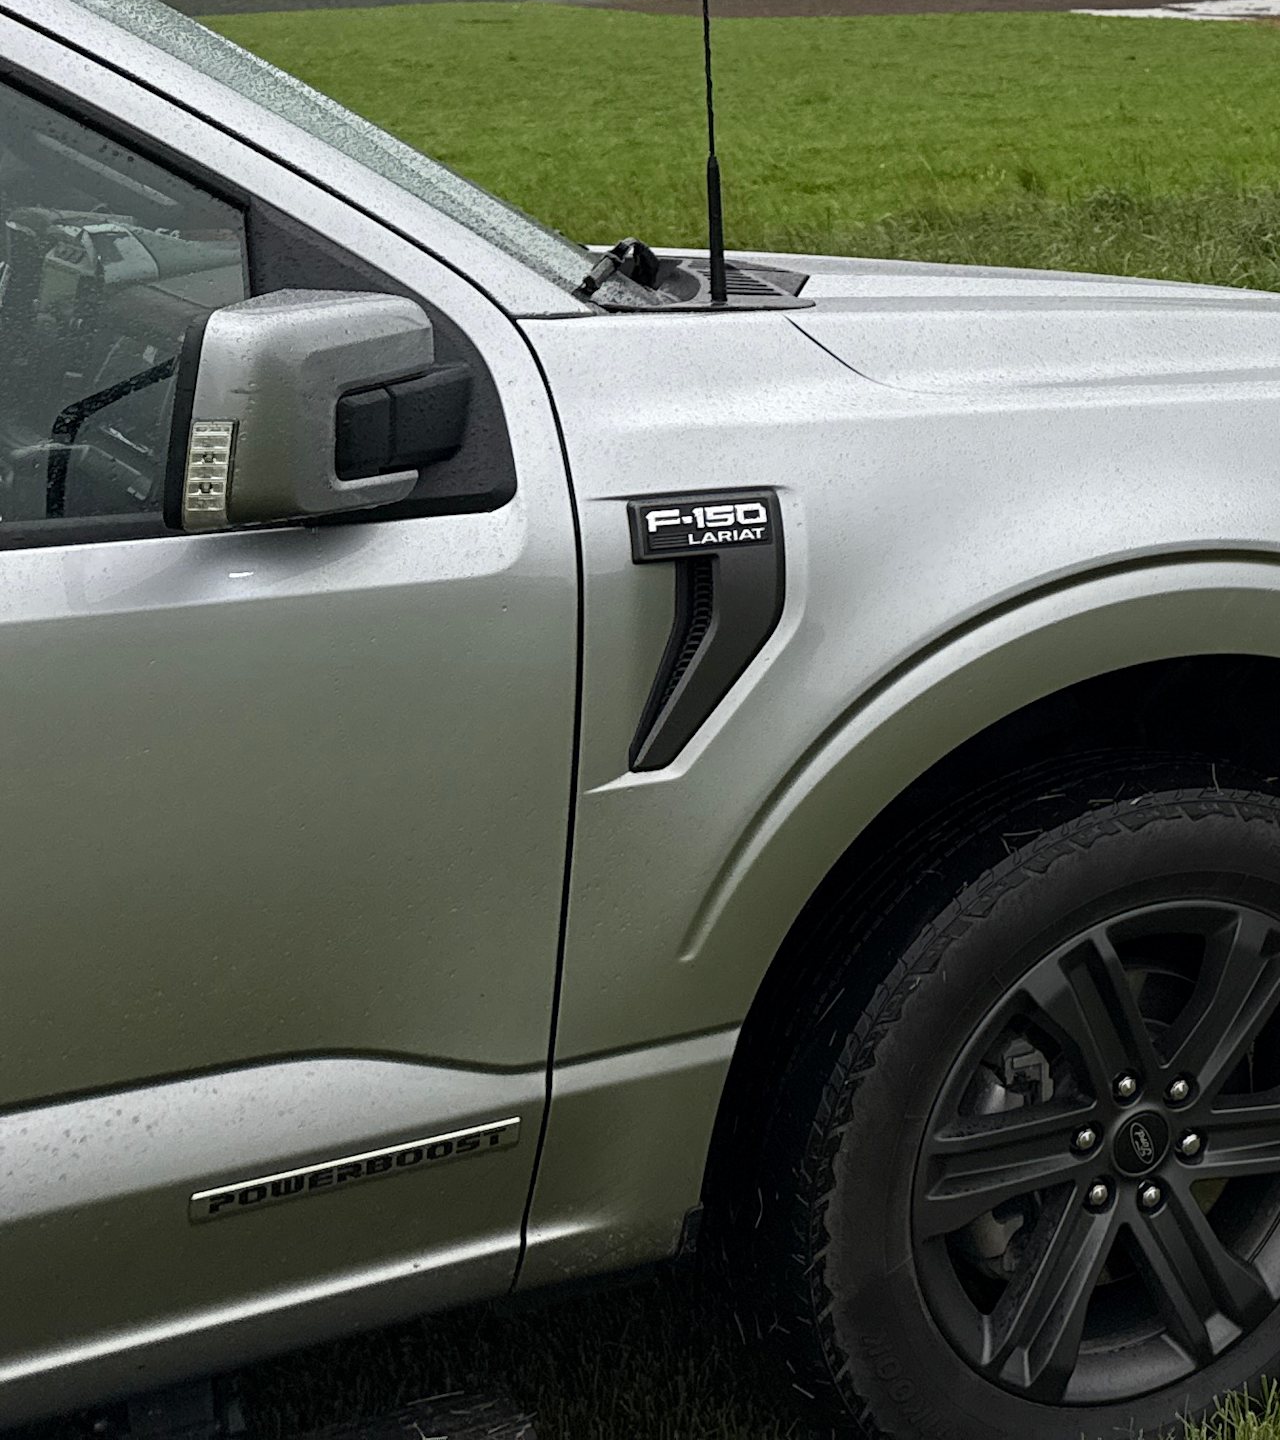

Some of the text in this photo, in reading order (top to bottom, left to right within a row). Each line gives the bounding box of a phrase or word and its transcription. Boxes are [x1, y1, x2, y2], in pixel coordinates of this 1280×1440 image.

[646, 503, 767, 532] F-150
[688, 527, 765, 545] LARIAT
[1134, 1130, 1152, 1157] Ford
[209, 1127, 506, 1213] POWERBOOST
